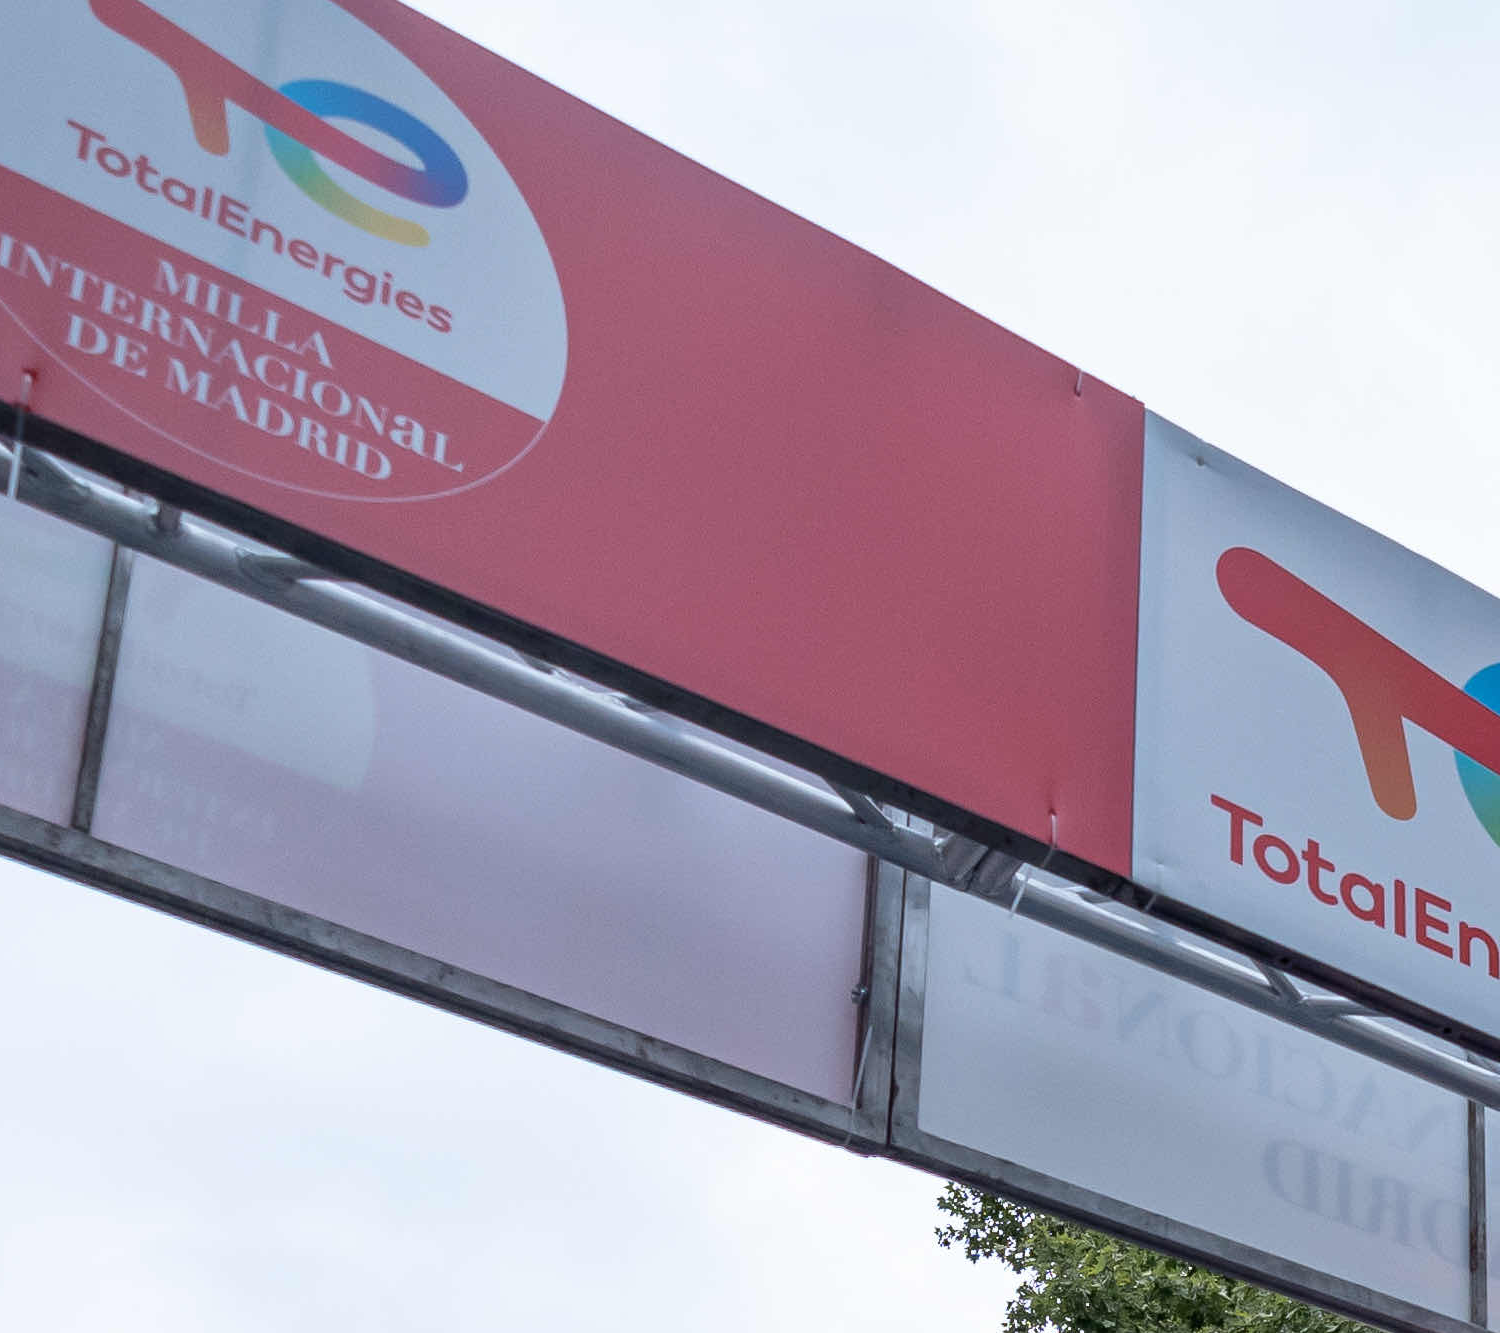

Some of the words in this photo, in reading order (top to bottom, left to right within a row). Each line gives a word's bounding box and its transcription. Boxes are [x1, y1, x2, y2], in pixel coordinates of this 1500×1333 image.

[66, 119, 454, 333] TotalEnergies
[66, 314, 148, 376] DE
[165, 364, 392, 481] MADRID
[155, 260, 335, 368] MILLA
